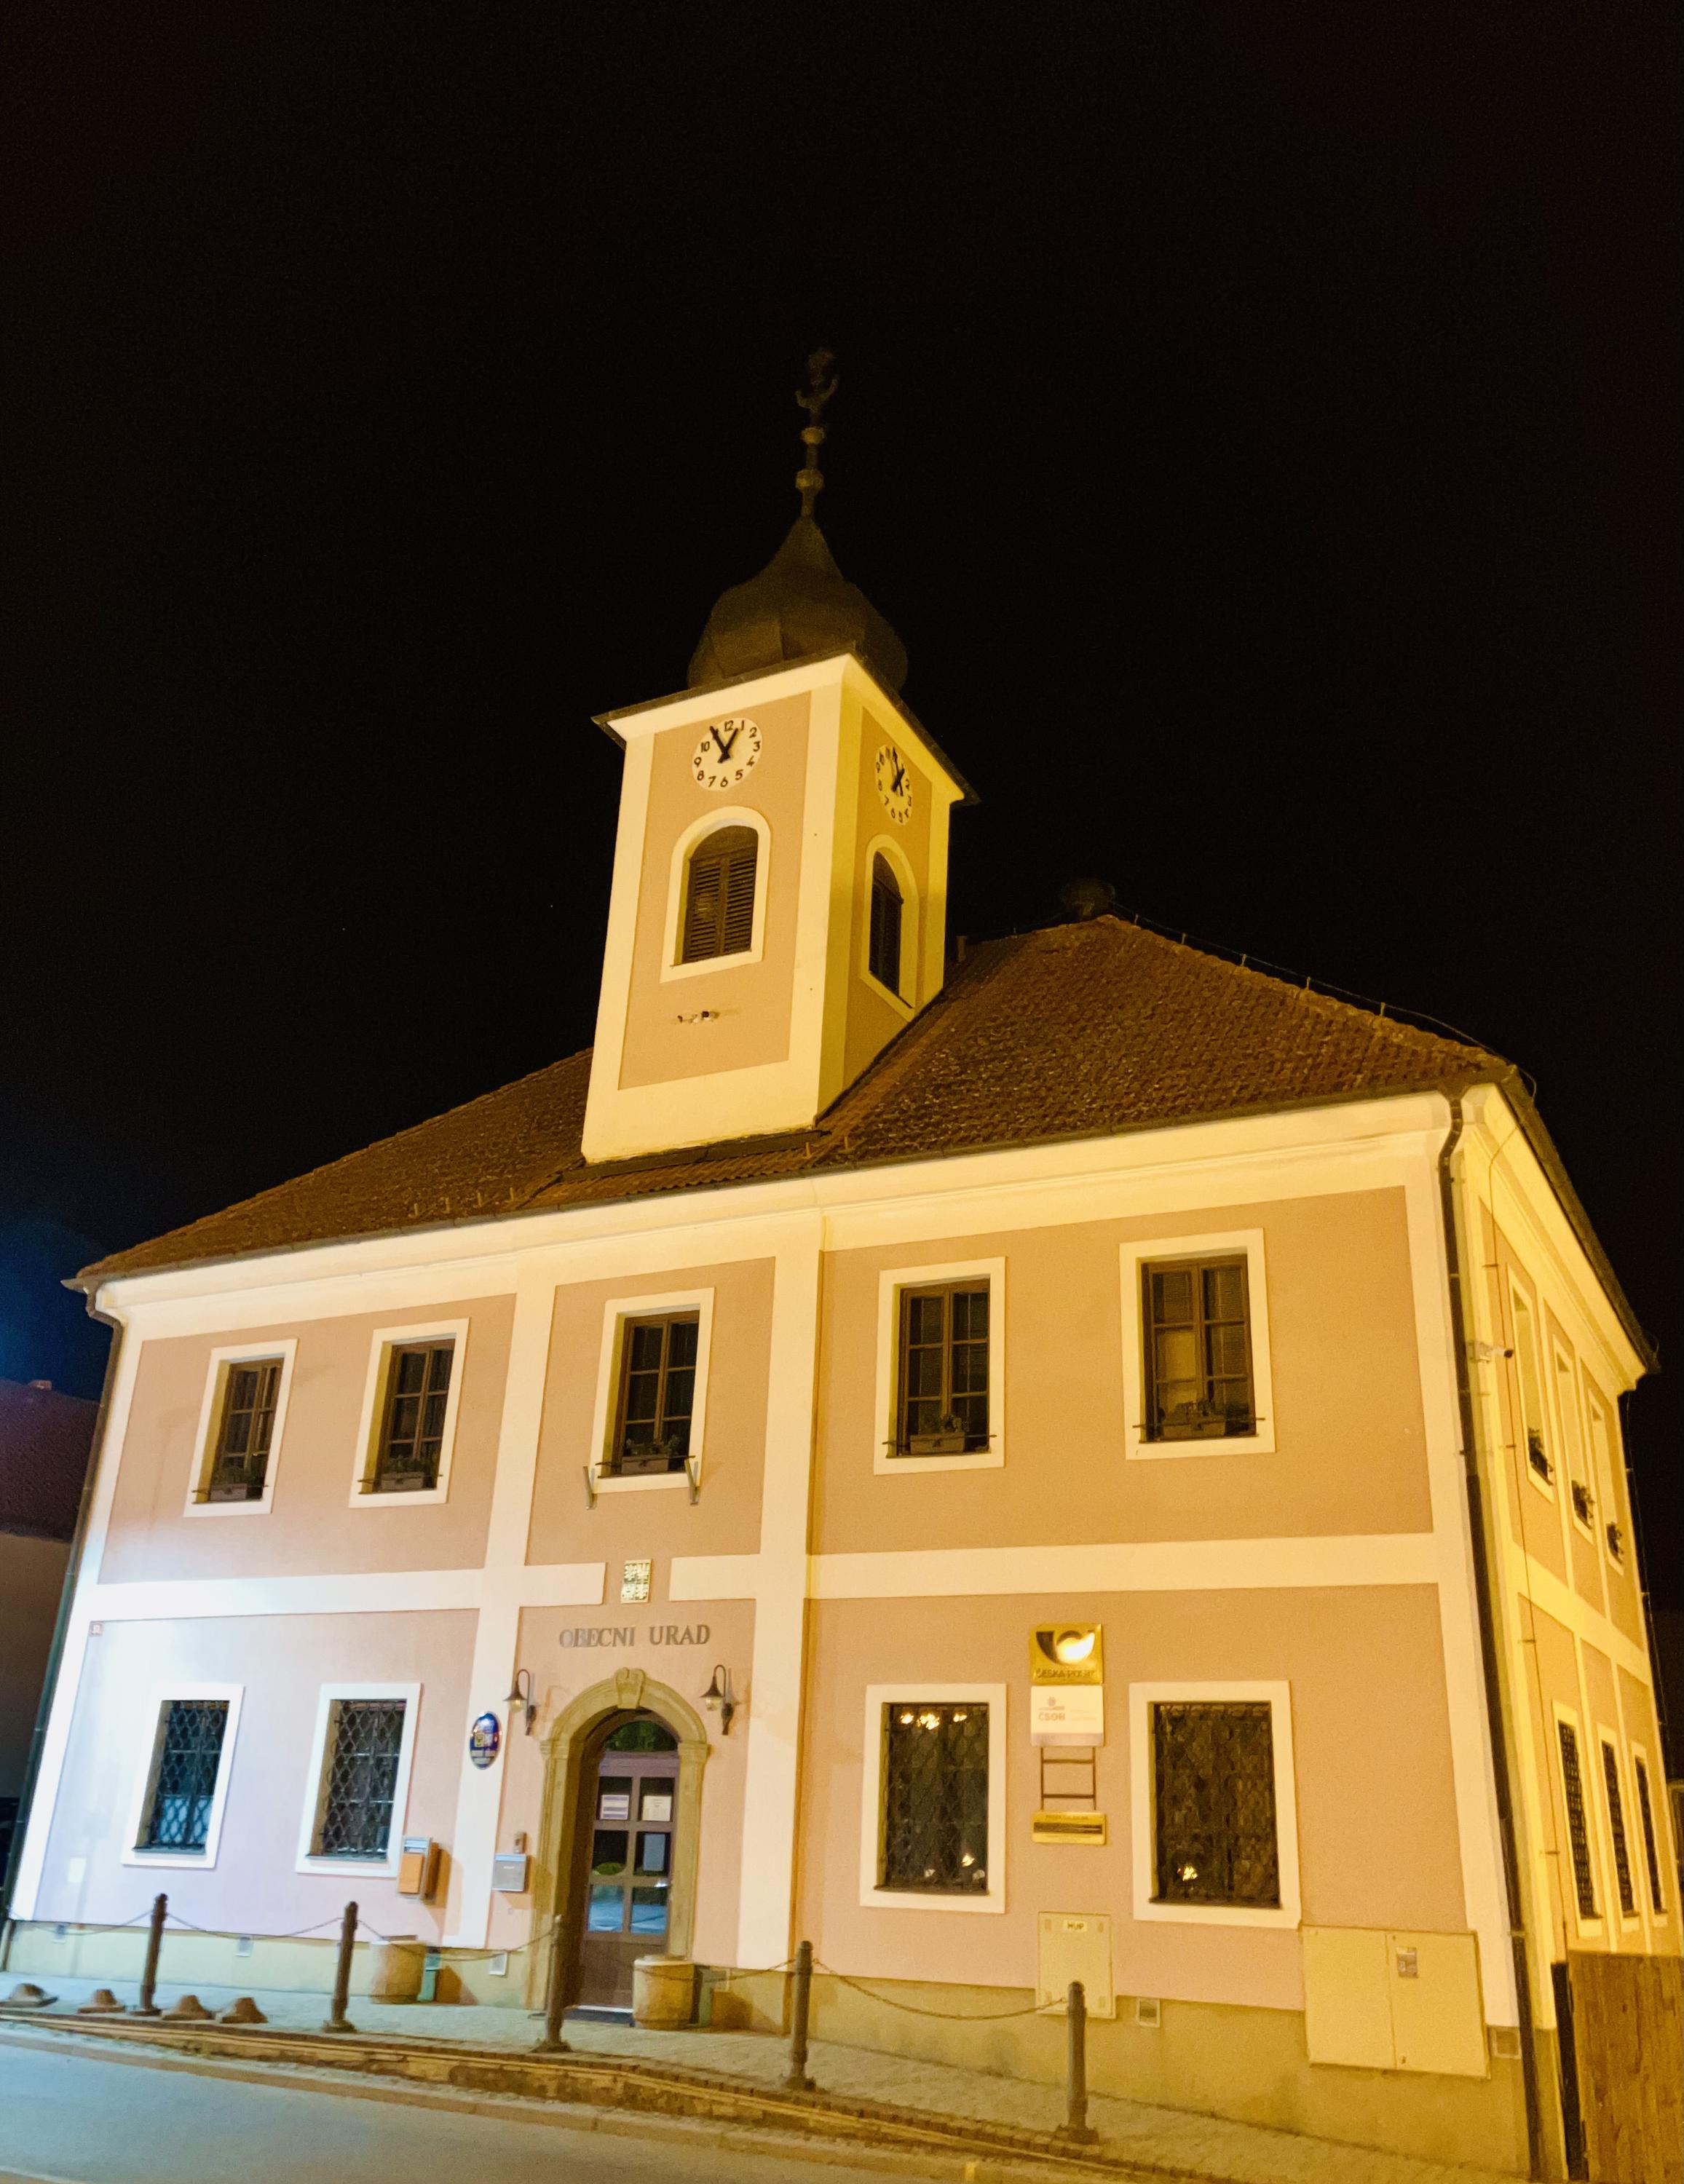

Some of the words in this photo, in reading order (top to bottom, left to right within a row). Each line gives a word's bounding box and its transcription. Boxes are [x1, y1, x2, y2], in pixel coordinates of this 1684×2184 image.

[724, 720, 734, 732] 12
[740, 719, 745, 731] 1
[748, 727, 757, 738] 2
[700, 741, 710, 753] 10
[753, 740, 761, 752] 3
[693, 756, 702, 768] 9
[746, 755, 755, 767] 4
[697, 770, 705, 781] 8
[735, 769, 743, 780] 5
[708, 775, 716, 788] 7
[719, 776, 729, 788] 6
